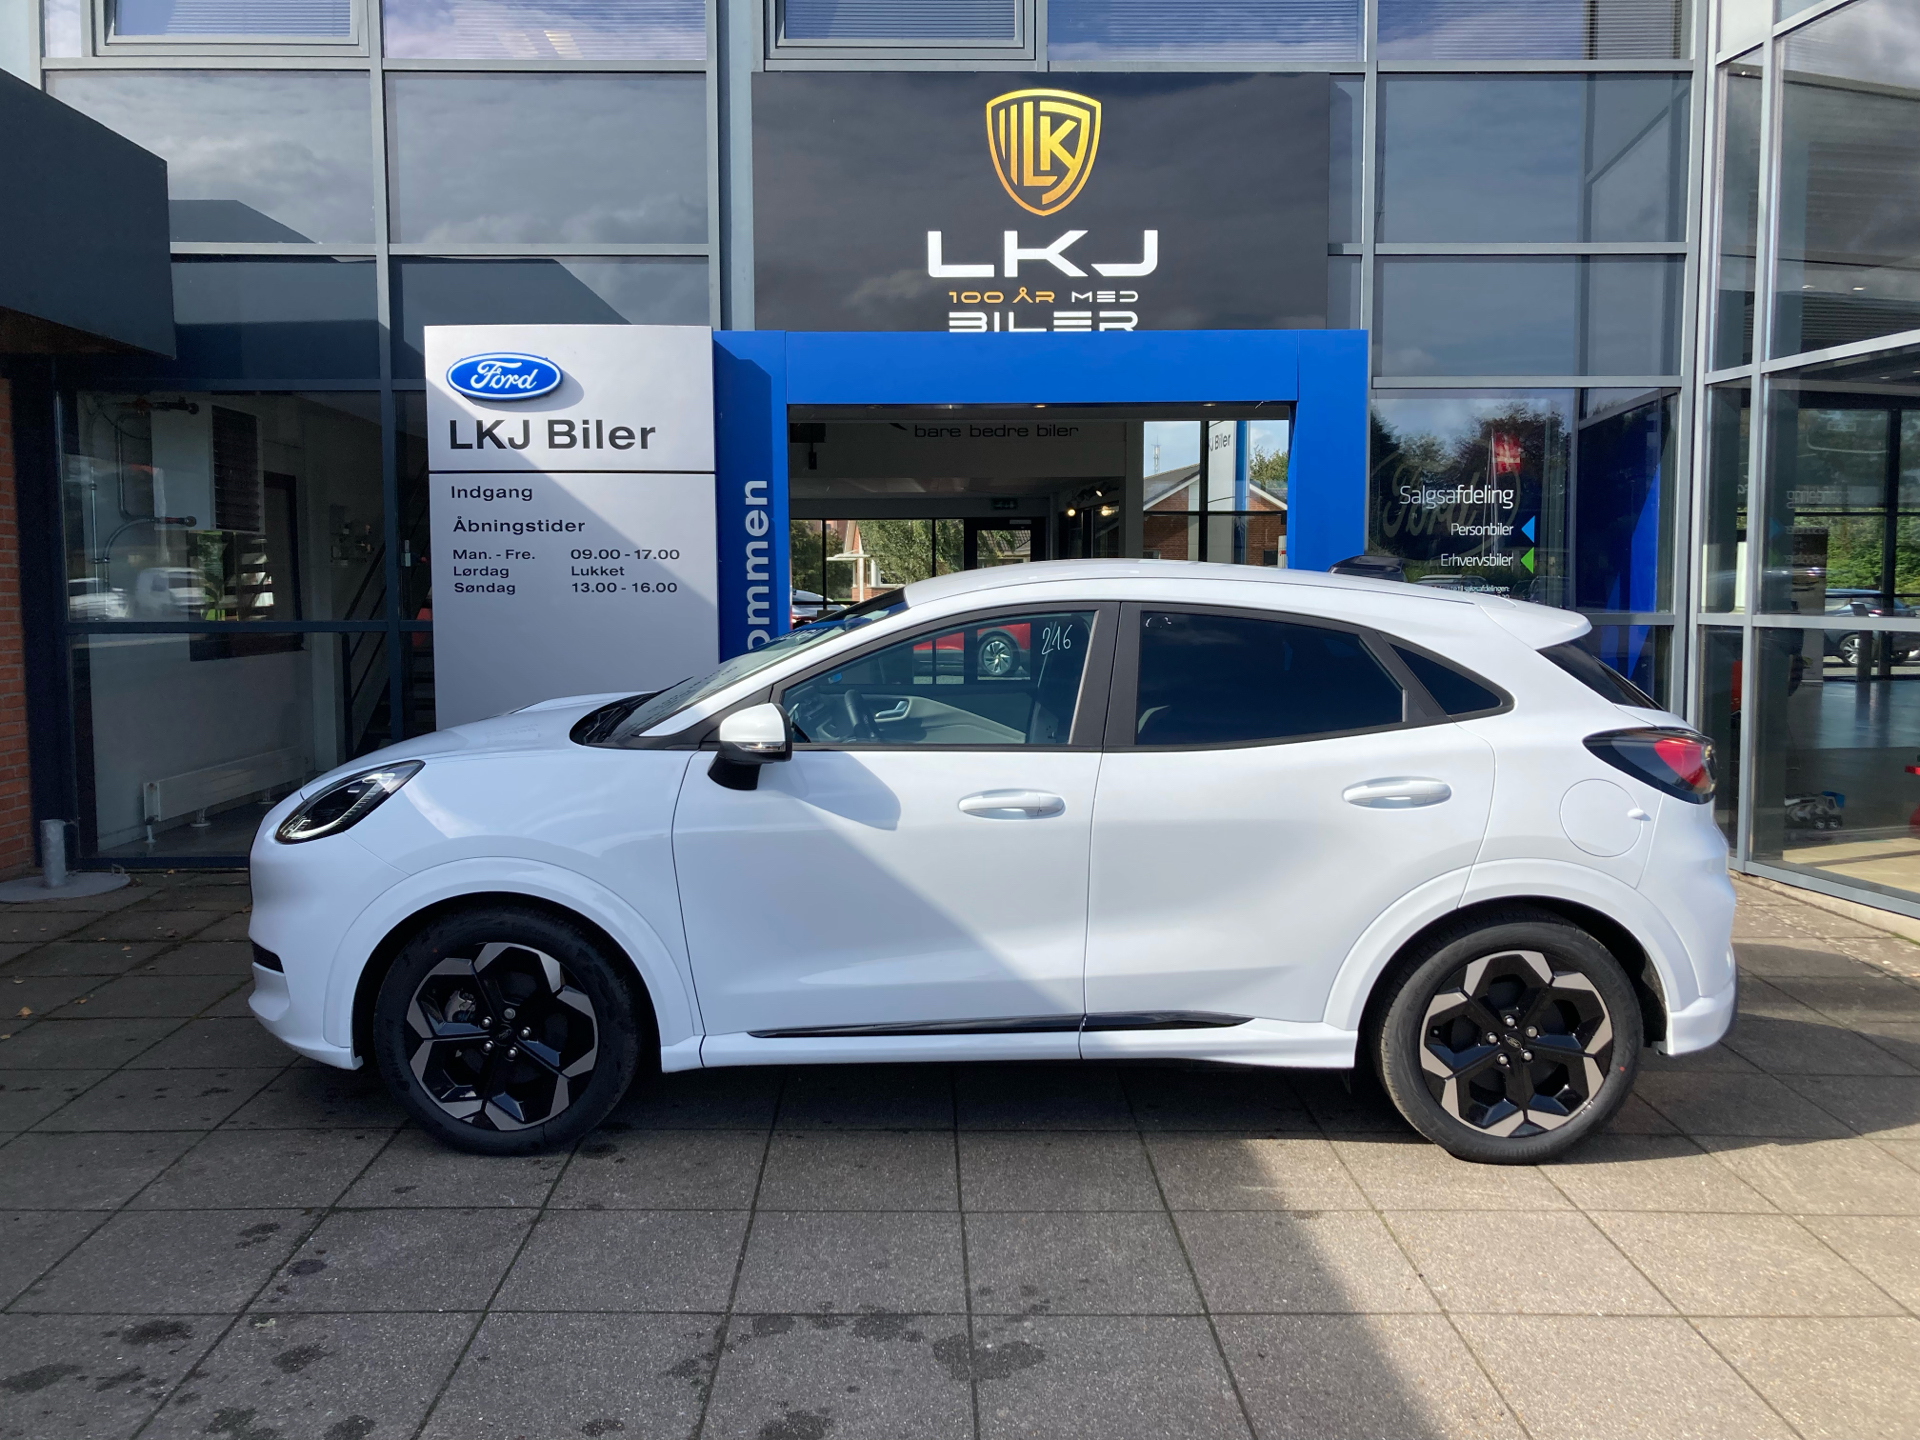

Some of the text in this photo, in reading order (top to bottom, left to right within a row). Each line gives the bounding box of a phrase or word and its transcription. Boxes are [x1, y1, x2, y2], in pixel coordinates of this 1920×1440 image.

[927, 229, 1159, 278] LKJ
[948, 286, 1139, 304] 100 ÅR MED
[470, 359, 539, 391] Ford
[450, 419, 656, 451] LKJ Biler
[914, 424, 1078, 438] bare bedre biler
[1214, 433, 1231, 451] Biler
[451, 485, 533, 501] Indgang
[1399, 484, 1515, 510] Salgsafdeling
[453, 515, 586, 535] Åbningstider
[1450, 522, 1515, 536] Personbiler
[453, 549, 492, 560] Man.
[505, 549, 535, 560] Fre.
[570, 548, 621, 560] 09.00
[634, 549, 681, 560] 17.00
[1440, 553, 1513, 567] Erhvervsbiler
[453, 565, 625, 578] Lørdag Lukket
[454, 582, 516, 595] Søndag
[572, 582, 617, 593] 13.00
[631, 582, 678, 593] 16.00
[1041, 624, 1073, 655] 216
